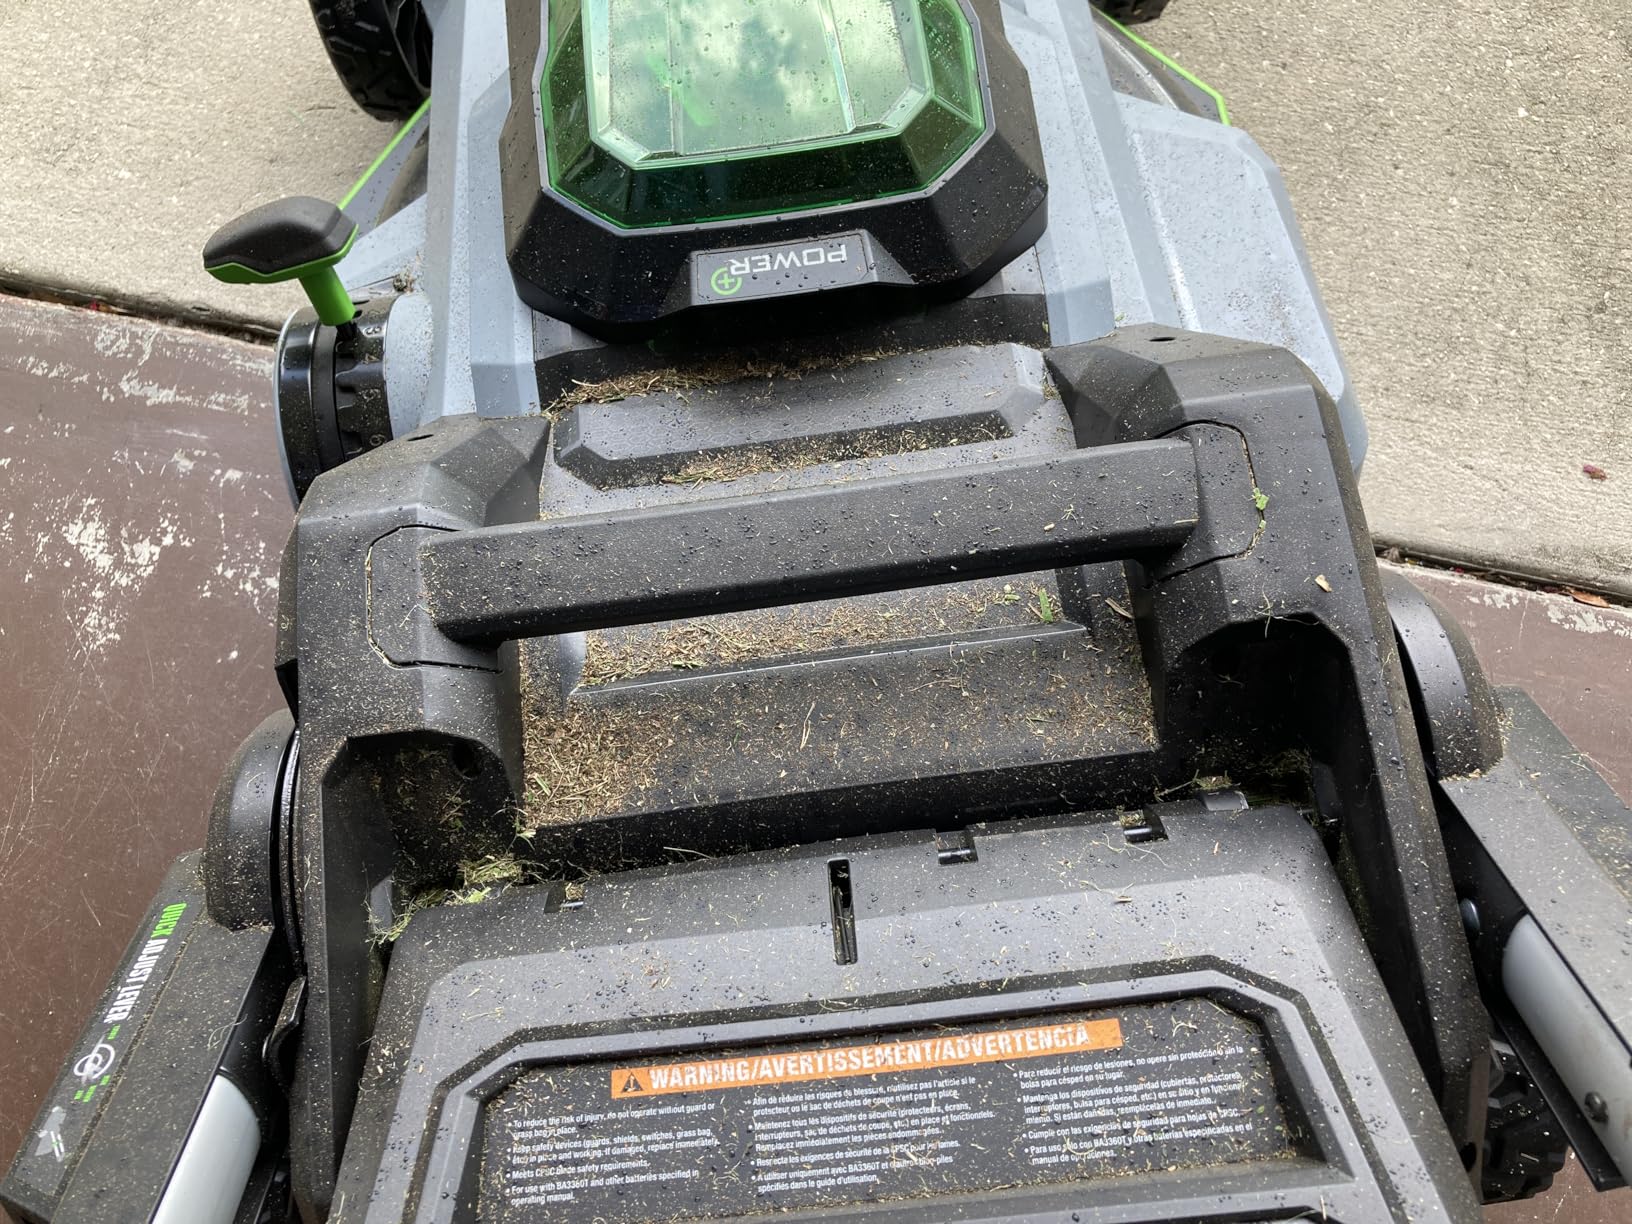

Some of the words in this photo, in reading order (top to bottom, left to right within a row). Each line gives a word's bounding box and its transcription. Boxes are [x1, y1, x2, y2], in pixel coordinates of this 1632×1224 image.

[728, 244, 848, 275] POWER
[151, 903, 187, 938] QUICK
[126, 938, 168, 983] ADJUST
[103, 984, 144, 1024] LEVER
[649, 1024, 1089, 1089] WARNING/AVERTISSEMENT/ADVERTENCIA
[1018, 1069, 1035, 1078] Para
[1036, 1066, 1061, 1076] reducir
[1062, 1065, 1069, 1073] el
[1070, 1063, 1092, 1073] riesgo
[1093, 1061, 1103, 1070] de
[1103, 1058, 1135, 1069] lesiones,
[1136, 1057, 1145, 1065] no
[1146, 1055, 1167, 1064] opere
[1167, 1052, 1178, 1061] sin
[1236, 1045, 1243, 1053] la
[752, 1096, 766, 1105] Afin
[767, 1095, 777, 1103] de
[778, 1092, 803, 1103] réduire
[804, 1091, 815, 1100] les
[816, 1089, 842, 1100] risques
[919, 1081, 932, 1090] pas
[933, 1077, 959, 1087] l'article
[960, 1076, 967, 1084] si
[968, 1075, 975, 1083] le
[1020, 1079, 1039, 1089] bolsa
[1040, 1078, 1057, 1087] para
[1058, 1075, 1083, 1085] césped
[1104, 1070, 1124, 1080] lugar.
[1022, 1092, 1057, 1103] Mantenga
[1058, 1090, 1070, 1099] los
[1070, 1086, 1112, 1098] dispositivos
[1124, 1079, 1159, 1091] seguridad
[1160, 1076, 1198, 1089] (cubiertas,
[753, 1106, 789, 1116] protecteur
[801, 1102, 808, 1110] le
[808, 1102, 821, 1110] sac
[822, 1101, 831, 1109] de
[833, 1098, 860, 1108] déchets
[862, 1097, 871, 1105] de
[872, 1096, 894, 1105] coupe
[895, 1092, 912, 1102] n'est
[913, 1092, 927, 1101] pas
[928, 1091, 937, 1099] en
[938, 1088, 959, 1098] place.
[1073, 1098, 1093, 1108] bolsa
[1094, 1097, 1110, 1106] para
[1111, 1093, 1139, 1104] césped,
[1157, 1090, 1167, 1098] en
[1194, 1087, 1199, 1095] y
[513, 1119, 521, 1127] To
[522, 1117, 547, 1127] reduce
[548, 1116, 560, 1124] the
[561, 1115, 574, 1123] risk
[575, 1114, 583, 1122] of
[584, 1112, 605, 1122] injury,
[617, 1110, 628, 1118] not
[630, 1108, 656, 1118] operate
[658, 1105, 684, 1114] without
[685, 1102, 705, 1113] guard
[754, 1119, 790, 1130] Maintenez
[791, 1118, 807, 1126] tous
[808, 1116, 819, 1124] les
[820, 1113, 856, 1125] dispositifs
[857, 1112, 867, 1120] de
[868, 1108, 896, 1119] sécurité
[897, 1103, 944, 1117] (protecteurs,
[944, 1102, 971, 1112] écrans,
[1025, 1114, 1052, 1124] miento.
[1053, 1112, 1061, 1120] Si
[1062, 1110, 1082, 1120] están
[1165, 1099, 1175, 1108] de
[556, 1125, 577, 1135] place.
[754, 1128, 803, 1141] interrupteurs,
[804, 1128, 817, 1136] sac
[818, 1126, 827, 1134] de
[828, 1123, 856, 1133] déchets
[857, 1122, 867, 1130] de
[868, 1121, 892, 1130] coupe,
[920, 1115, 940, 1125] place
[950, 1109, 995, 1121] fonctionnels.
[1028, 1128, 1054, 1139] Cumple
[1056, 1128, 1069, 1136] con
[1070, 1125, 1081, 1133] las
[1122, 1120, 1131, 1128] de
[1132, 1115, 1168, 1128] seguridad
[1169, 1114, 1186, 1124] para
[1186, 1111, 1206, 1122] hojas
[1030, 1144, 1047, 1153] Para
[1079, 1140, 1092, 1148] con
[1127, 1136, 1132, 1144] y
[1133, 1133, 1152, 1142] otras
[1184, 1124, 1233, 1137] especificadas
[1234, 1123, 1244, 1131] en
[1245, 1122, 1252, 1130] el
[531, 1142, 553, 1152] safety
[554, 1139, 581, 1148] devices
[676, 1129, 696, 1138] grass
[557, 1150, 571, 1159] and
[647, 1141, 673, 1152] replace
[755, 1140, 794, 1152] Remplacez
[795, 1134, 850, 1148] immédiatement
[851, 1133, 861, 1142] les
[863, 1132, 887, 1141] pièces
[788, 1154, 798, 1163] les
[800, 1151, 833, 1163] exigences
[834, 1150, 843, 1158] de
[844, 1147, 871, 1158] sécurité
[872, 1146, 882, 1155] de
[910, 1142, 925, 1151] pour
[511, 1169, 534, 1179] Meets
[576, 1163, 599, 1174] safety
[788, 1166, 829, 1179] uniquement
[830, 1166, 847, 1174] avec
[848, 1161, 880, 1172] BA3360T
[880, 1159, 888, 1168] et
[1031, 1154, 1058, 1164] manual
[1059, 1153, 1069, 1161] de
[511, 1185, 523, 1194] For
[539, 1182, 555, 1191] with
[589, 1177, 603, 1186] and
[604, 1175, 623, 1185] other
[624, 1172, 657, 1183] batteries
[658, 1169, 690, 1181] specified
[691, 1169, 699, 1177] in
[757, 1181, 789, 1193] spécifiés
[790, 1179, 807, 1188] dans
[808, 1178, 815, 1186] le
[816, 1177, 835, 1188] guide
[510, 1194, 545, 1207] operating
[546, 1191, 575, 1202] manual.
